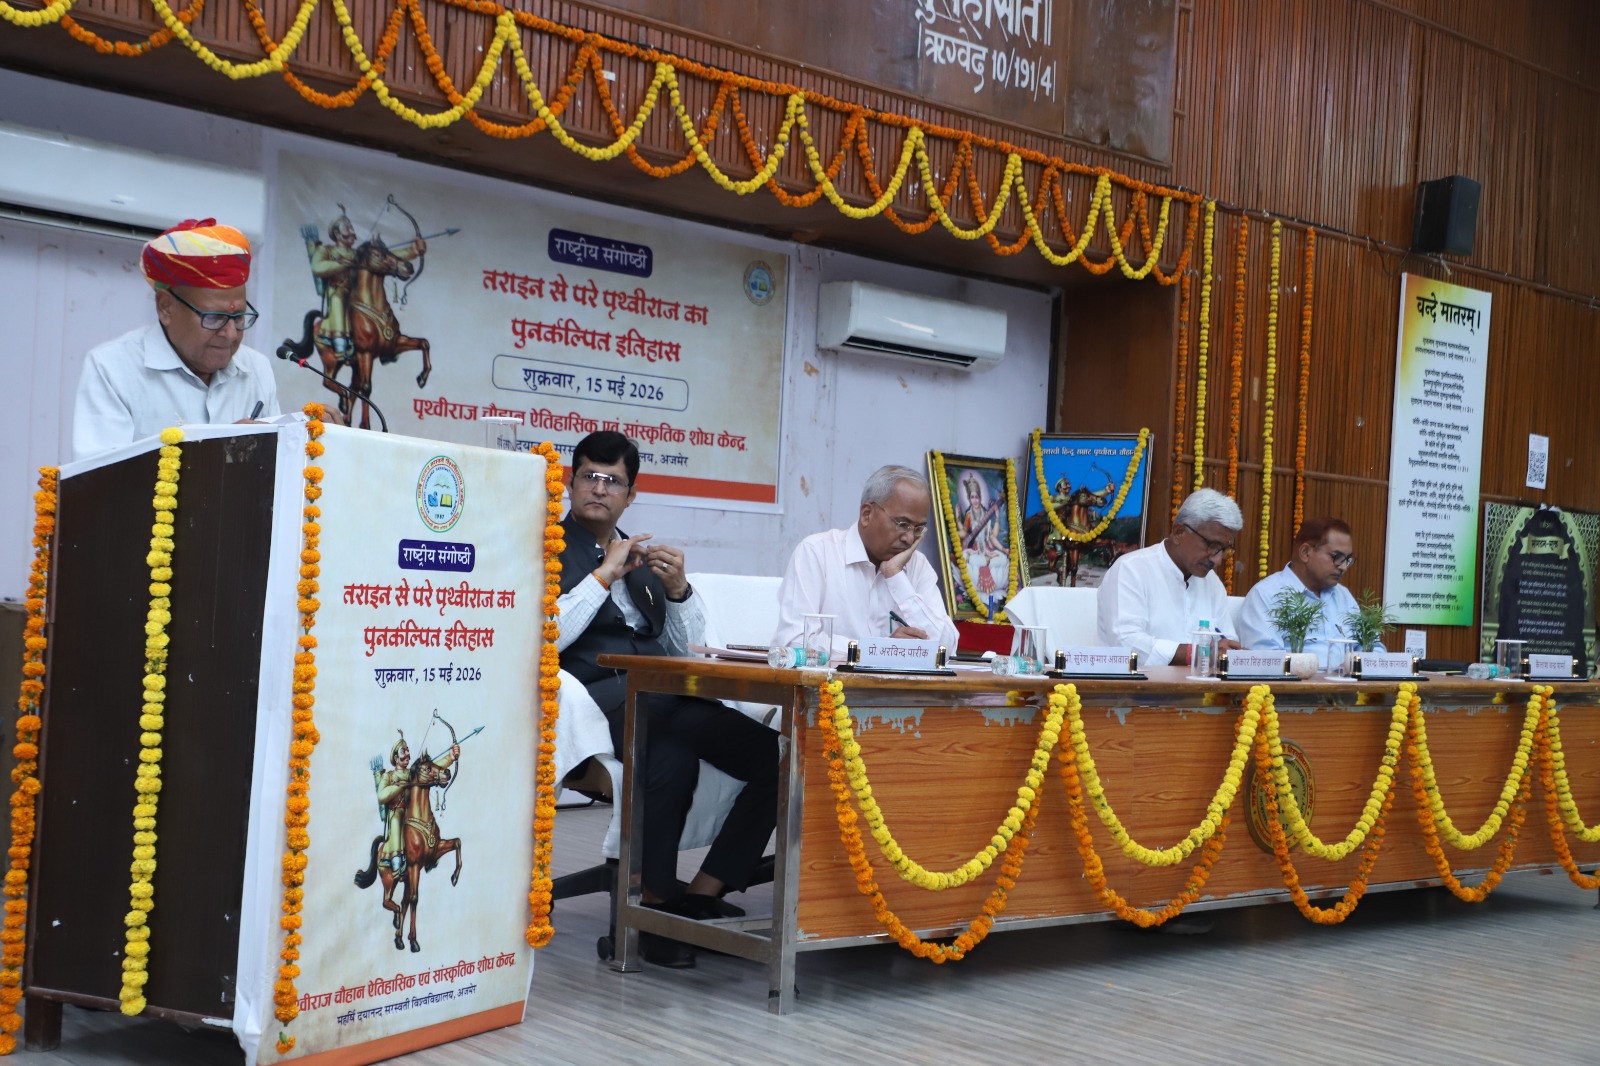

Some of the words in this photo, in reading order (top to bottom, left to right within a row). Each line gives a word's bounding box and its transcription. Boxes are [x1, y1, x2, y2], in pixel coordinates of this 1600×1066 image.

[555, 237, 599, 264] राष्ट्रीय
[603, 245, 648, 270] संगोष्ठी
[482, 270, 544, 299] तराइन
[549, 274, 568, 302] से
[573, 280, 598, 308] परे
[603, 288, 680, 321] पृथ्वीराज
[684, 303, 709, 325] का
[1417, 292, 1438, 323] वन्दे
[511, 317, 612, 352] पुनर्कल्पित
[615, 328, 681, 363] इतिहास
[587, 377, 603, 393] 15
[608, 378, 625, 400] मई
[629, 382, 664, 401] 2026
[413, 396, 477, 421] पृथ्वीराज
[529, 408, 599, 434] ऐतिहासिक
[623, 417, 685, 445] सांस्कृतिक
[689, 427, 714, 447] शोध
[660, 450, 688, 467] अजमेर
[402, 544, 435, 566] राष्ट्रीय
[438, 548, 472, 565] संगोष्ठी
[343, 583, 392, 609] तराइन
[395, 578, 409, 606] से
[413, 579, 433, 608] परे
[435, 581, 494, 616] पृथ्वीराज
[496, 590, 515, 609] का
[364, 619, 441, 657] पुनर्कल्पित
[445, 620, 494, 651] इतिहास
[868, 644, 878, 656] प्रो.
[879, 645, 906, 658] अरविन्द
[908, 645, 930, 658] पारीक
[423, 667, 436, 681] 15
[439, 662, 454, 684] मई
[456, 667, 482, 682] 2026
[1073, 652, 1089, 665] सुरेश
[1089, 654, 1107, 666] कुमार
[334, 986, 365, 1004] चौहान
[367, 974, 416, 998] ऐतिहासिक
[418, 967, 431, 986] एवं
[432, 960, 475, 984] सांस्कृतिक
[477, 955, 495, 974] शोध
[337, 1009, 356, 1026] महर्षि
[357, 1005, 383, 1022] दयानन्द
[384, 998, 410, 1016] सरस्वती
[457, 983, 477, 998] अजमेर
